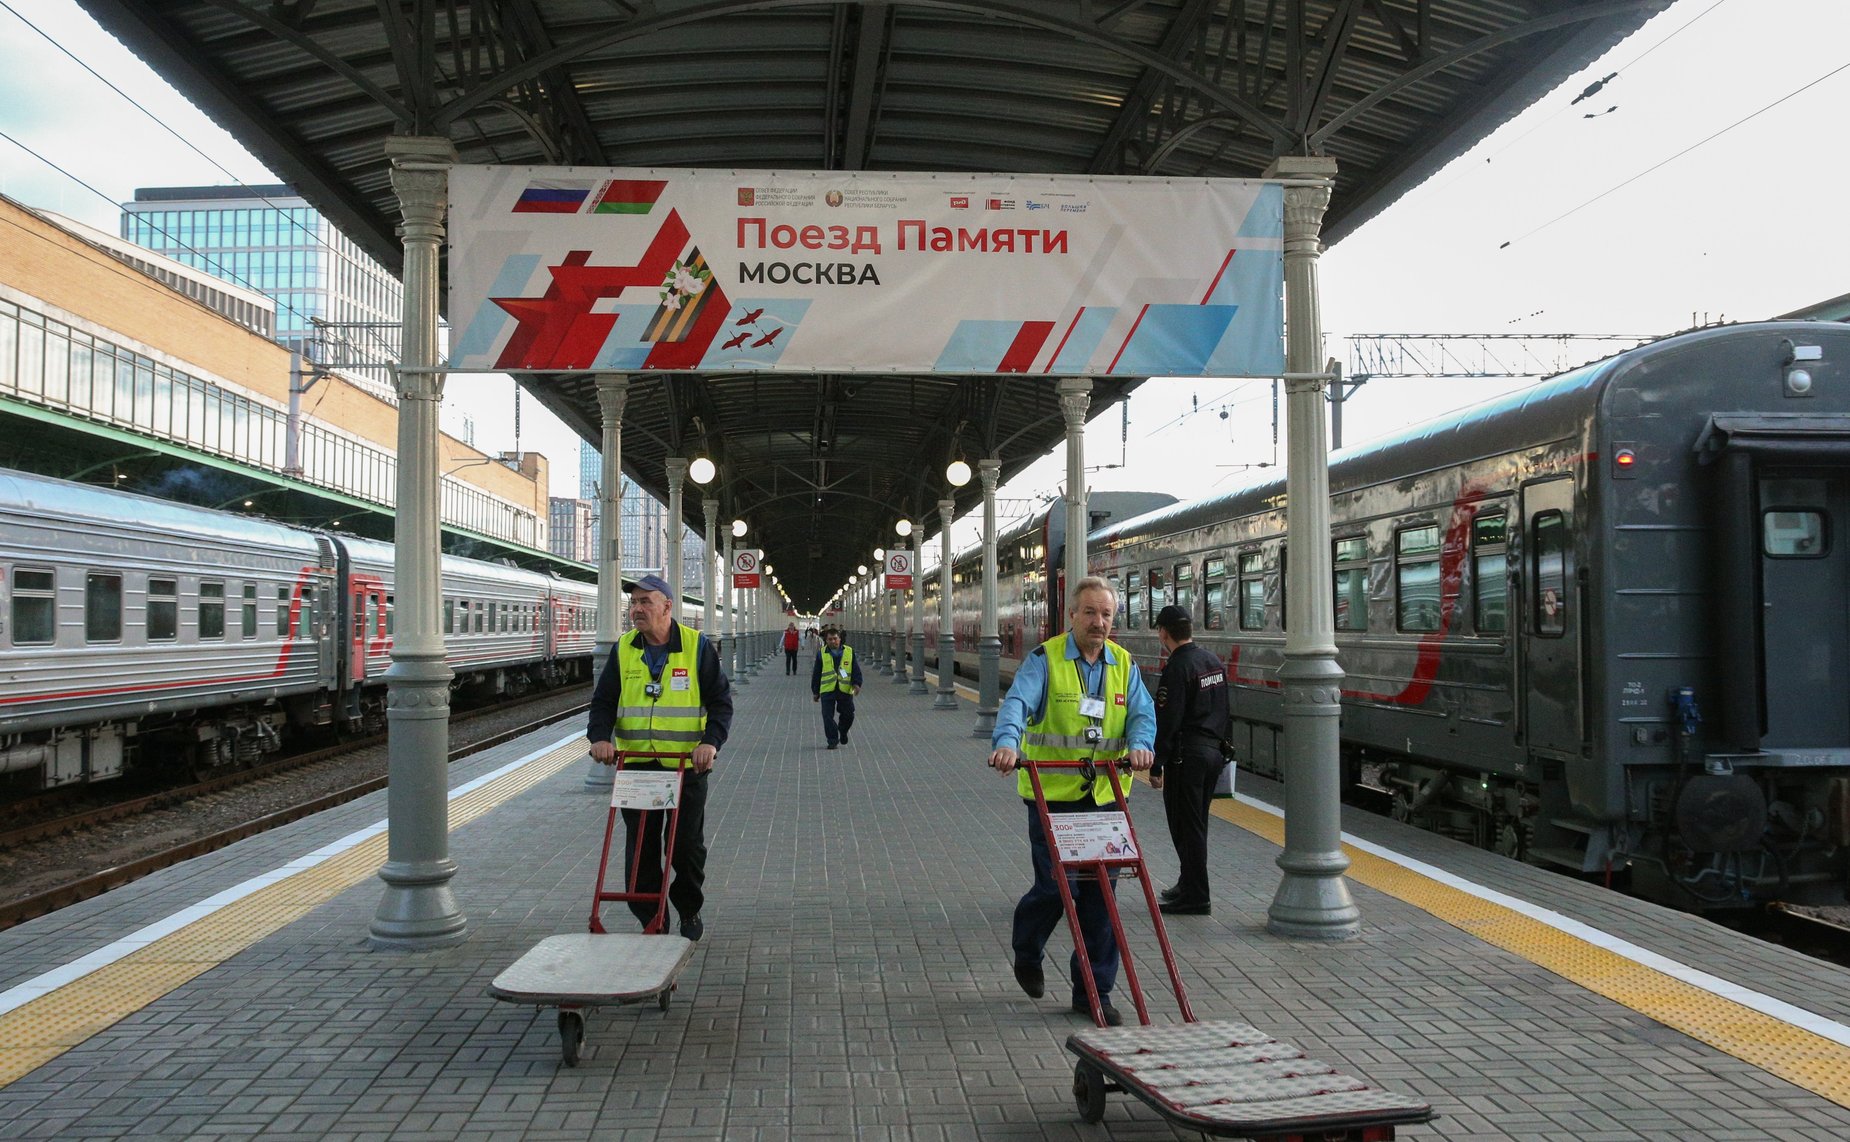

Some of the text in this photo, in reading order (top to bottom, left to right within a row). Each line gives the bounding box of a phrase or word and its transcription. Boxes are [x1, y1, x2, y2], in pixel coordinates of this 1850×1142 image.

[737, 217, 1068, 255] Поезд Памяти
[739, 261, 881, 286] МОСКВА
[1200, 673, 1224, 688] ПОЛИЦИЯ
